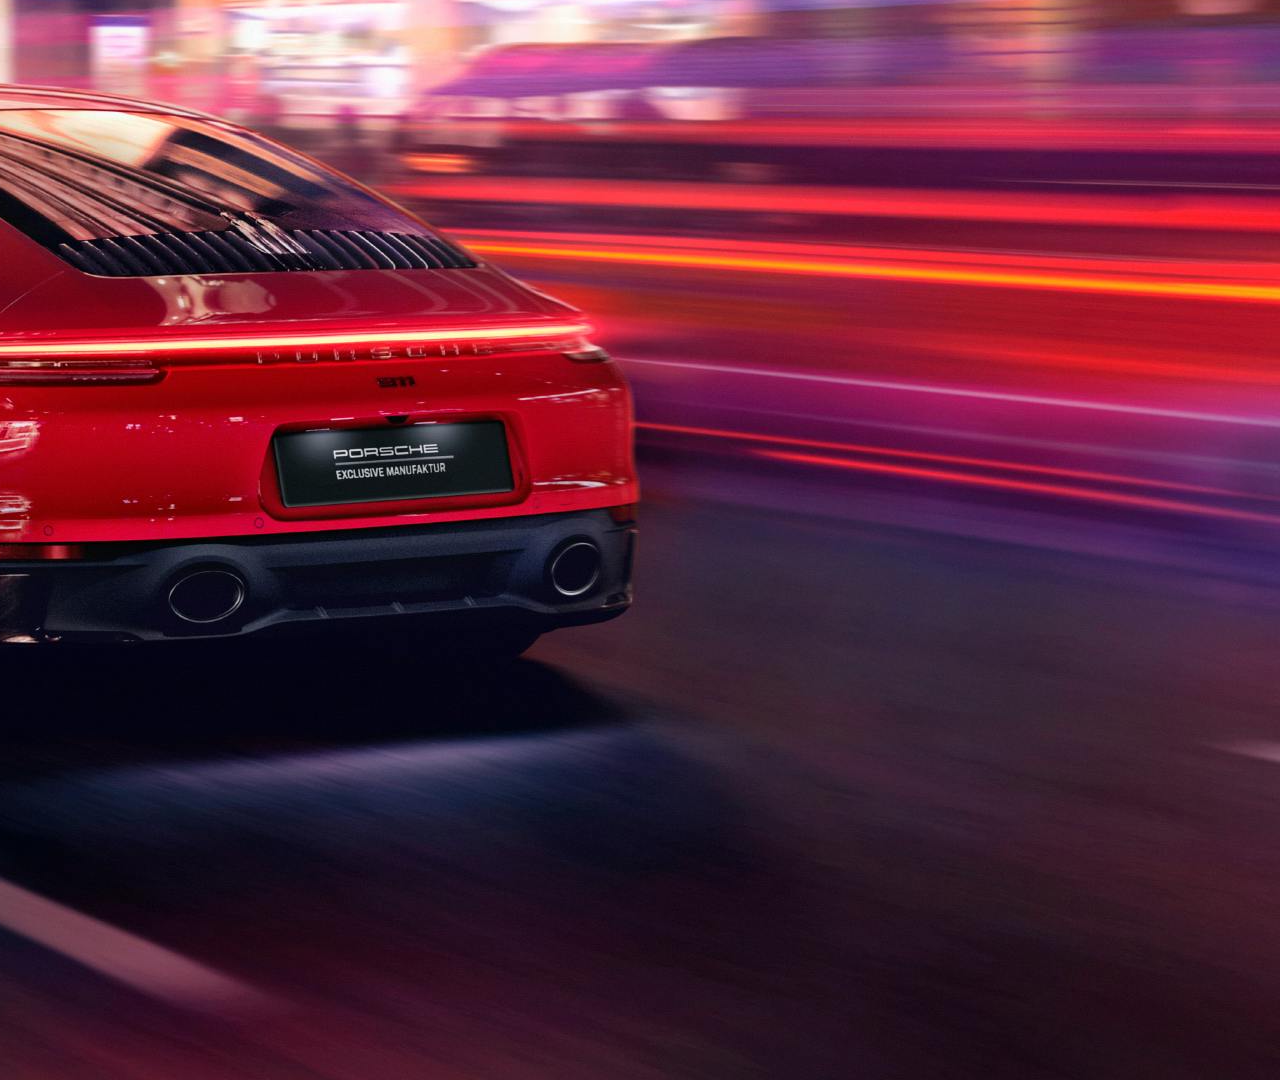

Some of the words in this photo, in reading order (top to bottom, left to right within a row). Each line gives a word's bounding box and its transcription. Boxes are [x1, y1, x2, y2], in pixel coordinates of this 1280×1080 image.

[333, 443, 439, 460] PORSCHE
[335, 467, 385, 480] EXCLUSIVE
[386, 462, 446, 477] MANUFAKTUR
